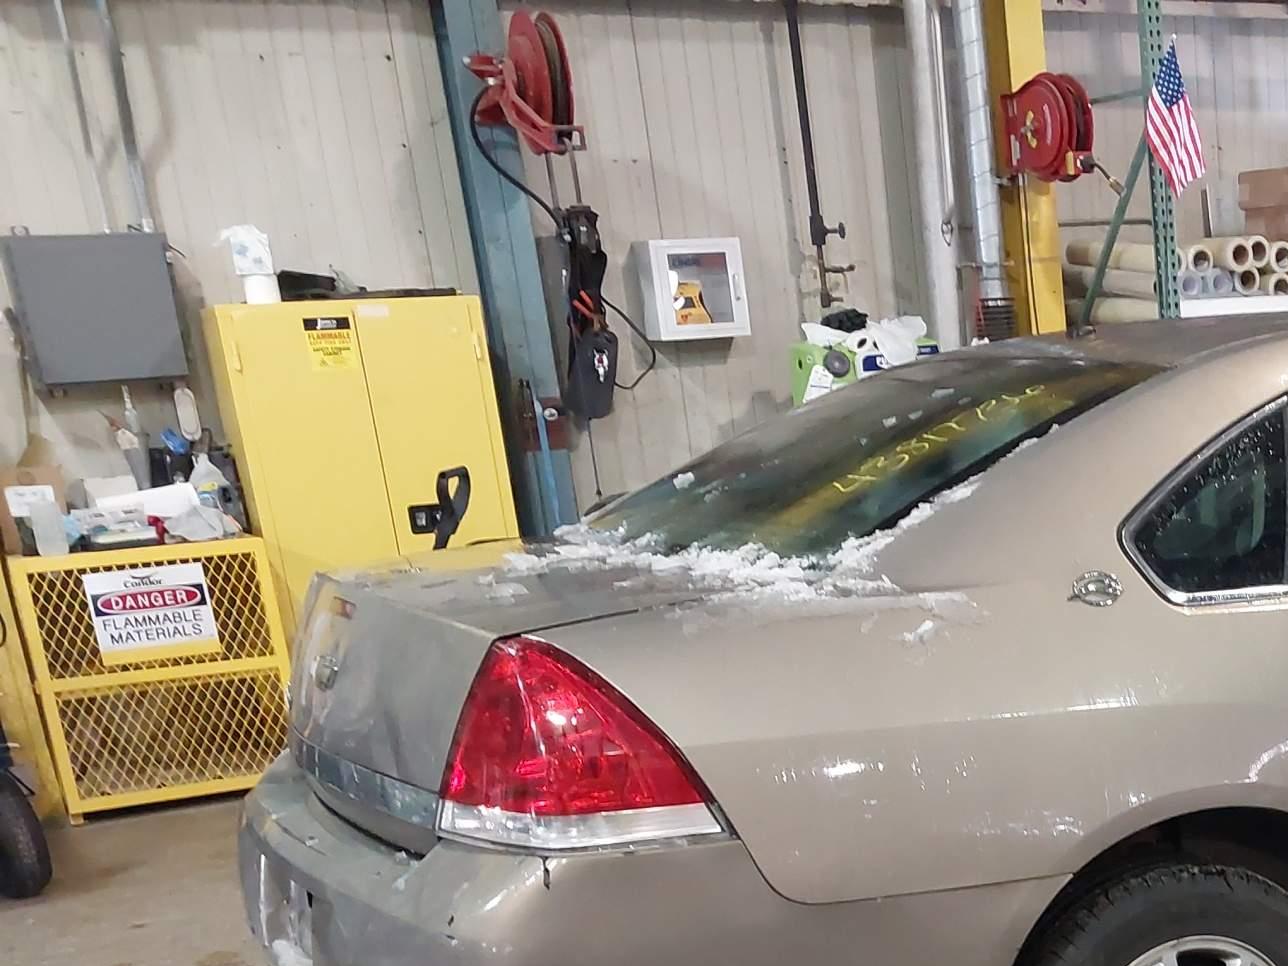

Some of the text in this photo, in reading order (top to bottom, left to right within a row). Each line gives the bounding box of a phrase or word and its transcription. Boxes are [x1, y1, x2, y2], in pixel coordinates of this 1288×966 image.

[123, 579, 162, 589] Condor
[110, 589, 189, 610] DANGER
[102, 608, 204, 632] FLAMMABLE
[109, 622, 203, 646] MATERIALS
